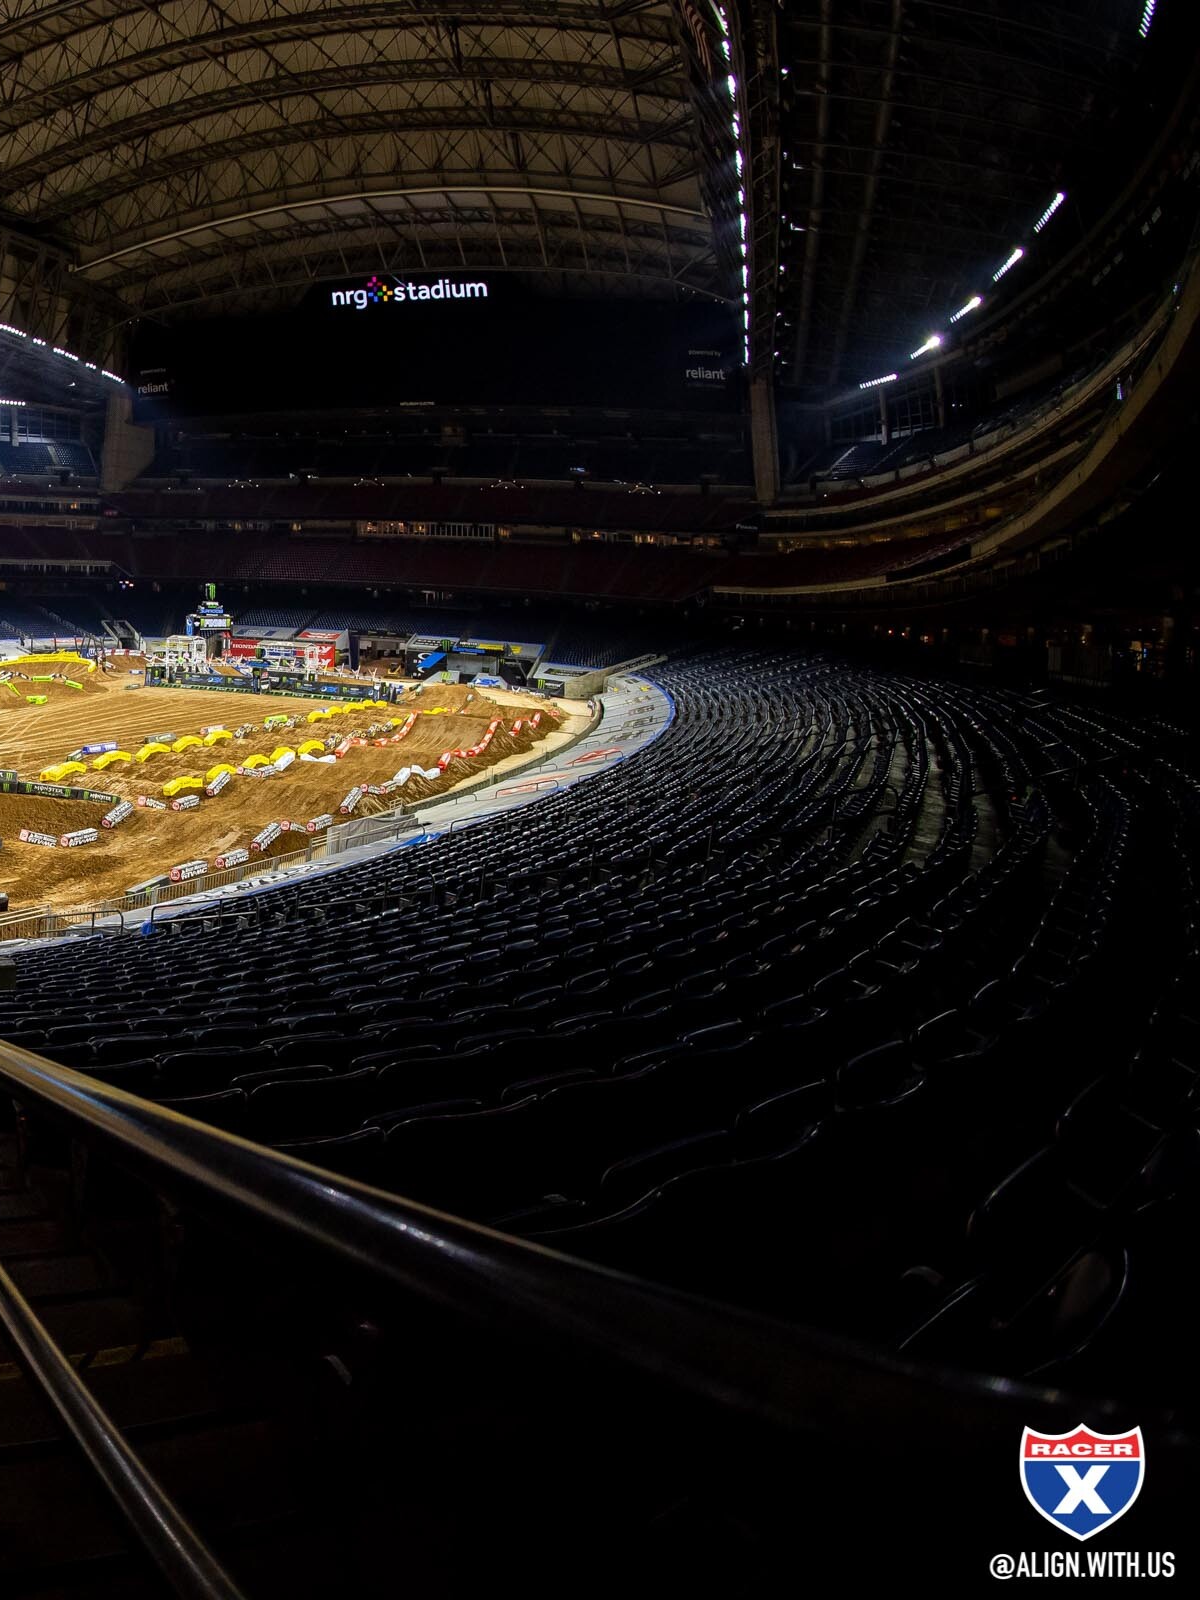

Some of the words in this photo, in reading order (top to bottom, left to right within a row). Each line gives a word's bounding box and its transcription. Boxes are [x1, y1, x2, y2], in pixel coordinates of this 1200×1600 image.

[332, 289, 367, 309] nrg
[394, 279, 487, 301] stadium
[686, 367, 726, 380] reliant
[138, 382, 169, 394] reliant
[34, 785, 64, 794] MONSTER
[90, 793, 112, 801] MONSTER
